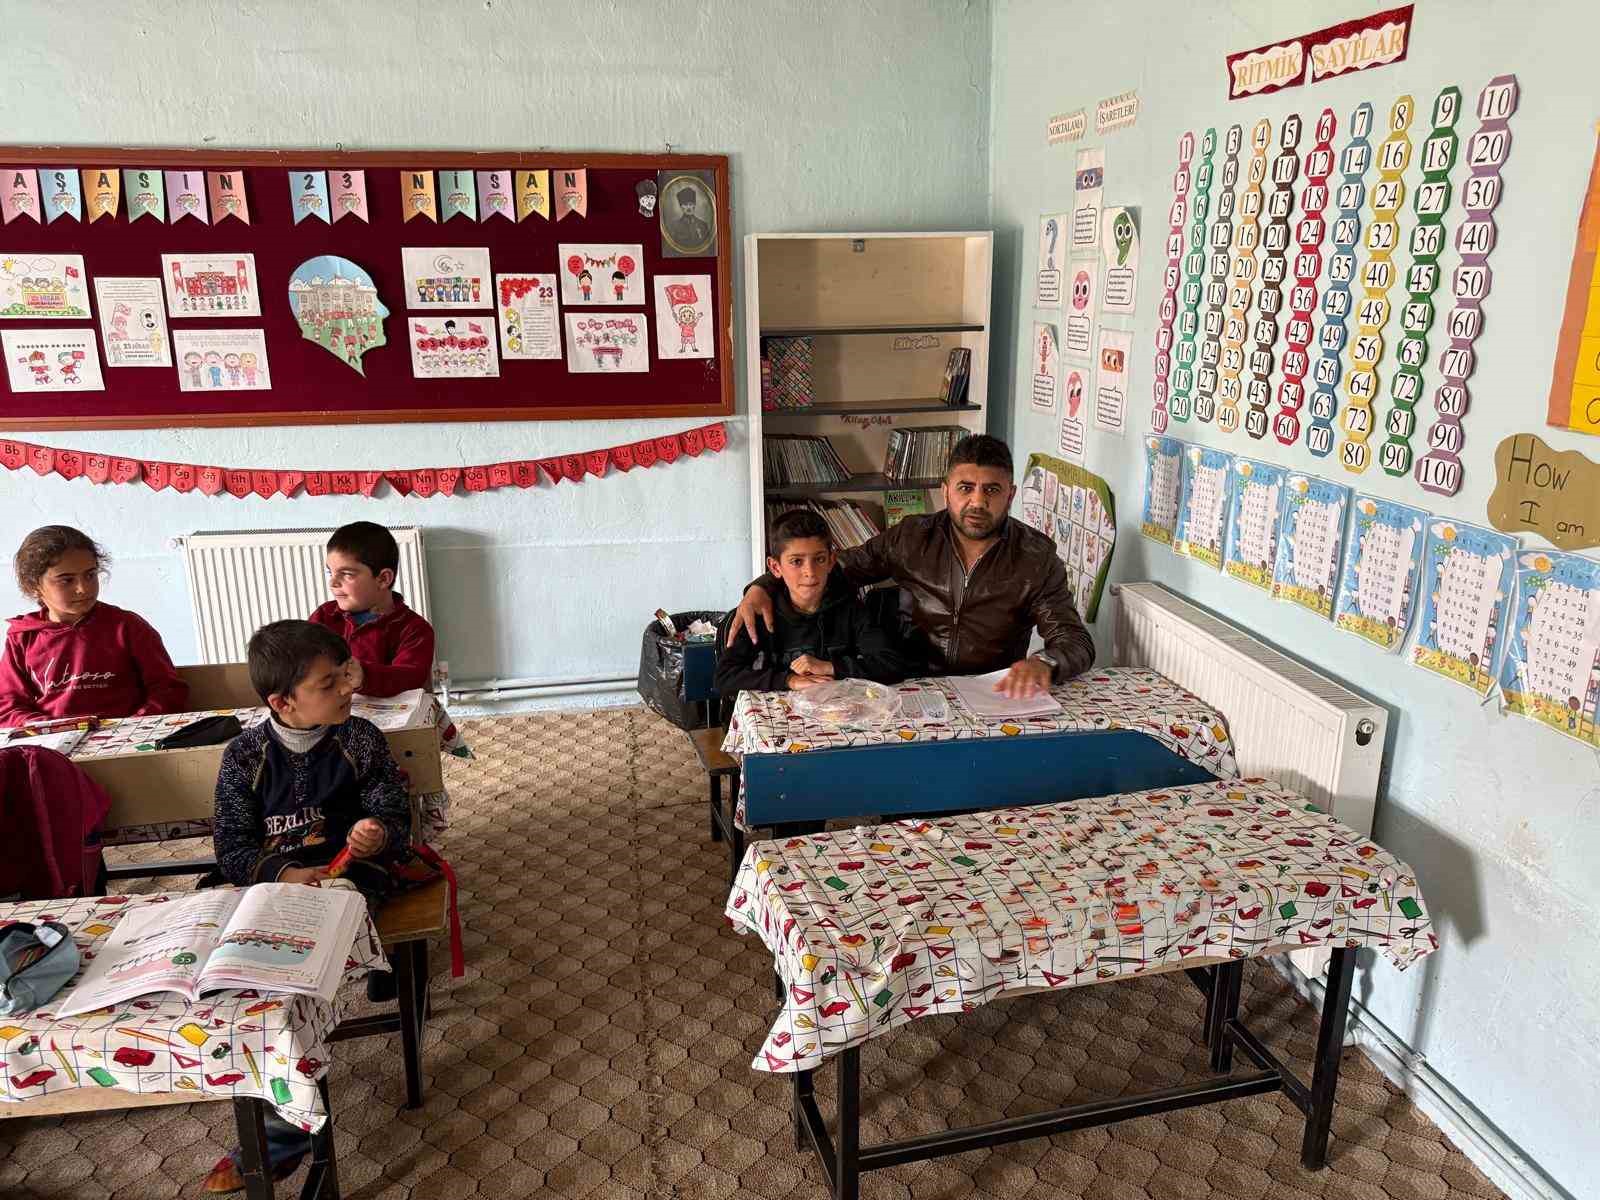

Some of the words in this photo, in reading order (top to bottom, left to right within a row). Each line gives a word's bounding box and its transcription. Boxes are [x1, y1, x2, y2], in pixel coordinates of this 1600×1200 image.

[1236, 51, 1299, 88] RİTMİK
[1439, 97, 1453, 122] 9
[1486, 88, 1510, 116] 10
[1049, 119, 1083, 135] NOKTALAMA
[1358, 112, 1366, 135] 7
[1396, 105, 1406, 129] 8
[1257, 126, 1265, 146] 4
[1287, 122, 1294, 145] 5
[1321, 118, 1329, 140] 6
[1185, 141, 1189, 159] 1
[1203, 137, 1210, 154] 2
[1230, 131, 1237, 151] 3
[1475, 136, 1503, 162] 20
[1312, 152, 1327, 175] 12
[1347, 151, 1364, 172] 14
[1383, 143, 1403, 168] 16
[1427, 141, 1449, 167] 18
[303, 174, 353, 190] 23
[412, 170, 576, 190] NİSAN
[1200, 170, 1208, 185] 4
[1226, 164, 1232, 181] 6
[1253, 160, 1261, 180] 8
[1278, 159, 1293, 180] 10
[1179, 174, 1185, 191] 2
[1245, 194, 1258, 214] 12
[1307, 188, 1323, 210] 18
[1341, 186, 1359, 208] 21
[1376, 184, 1397, 208] 24
[1421, 186, 1445, 210] 27
[1468, 180, 1495, 207] 30
[1175, 205, 1182, 222] 3
[1198, 199, 1204, 215] 6
[1223, 196, 1230, 215] 9
[1273, 195, 1288, 215] 15
[1195, 229, 1201, 244] 8
[1214, 226, 1228, 245] 12
[1241, 227, 1253, 245] 16
[1268, 227, 1284, 248] 20
[1302, 221, 1319, 242] 24
[1337, 221, 1353, 242] 28
[1370, 224, 1391, 248] 32
[1415, 228, 1439, 252] 36
[1463, 225, 1489, 250] 40
[1171, 238, 1178, 255] 4
[1189, 255, 1201, 271] 10
[1214, 256, 1226, 273] 15
[1236, 259, 1250, 279] 20
[1265, 261, 1281, 280] 25
[1298, 256, 1314, 277] 30
[1332, 257, 1352, 279] 35
[1169, 271, 1175, 286] 5
[1367, 264, 1389, 286] 40
[1411, 267, 1433, 291] 45
[1458, 271, 1483, 296] 50
[539, 287, 553, 298] 23
[1187, 285, 1197, 302] 12
[1210, 285, 1224, 302] 18
[1232, 289, 1247, 308] 24
[1262, 291, 1276, 310] 30
[1294, 288, 1312, 307] 36
[1327, 292, 1346, 314] 42
[1164, 301, 1171, 316] 6
[1361, 302, 1383, 325] 48
[1405, 307, 1427, 329] 54
[1184, 312, 1193, 332] 14
[1208, 313, 1219, 332] 21
[1229, 321, 1242, 339] 28
[1257, 323, 1272, 342] 35
[1290, 321, 1307, 343] 42
[1453, 312, 1476, 336] 60
[1162, 331, 1168, 345] 7
[1323, 326, 1340, 347] 49
[1180, 342, 1192, 361] 16
[1204, 343, 1216, 360] 24
[1355, 338, 1376, 360] 56
[1401, 342, 1423, 364] 63
[1159, 358, 1165, 373] 8
[1224, 350, 1238, 370] 32
[1254, 353, 1268, 372] 40
[1287, 351, 1303, 374] 48
[1449, 351, 1468, 376] 70
[1177, 371, 1188, 389] 18
[1200, 370, 1214, 388] 27
[1319, 361, 1335, 382] 56
[1157, 385, 1163, 402] 9
[1222, 379, 1236, 399] 36
[1251, 382, 1266, 404] 45
[1351, 373, 1371, 396] 64
[1398, 376, 1417, 399] 72
[1174, 398, 1186, 416] 20
[1282, 385, 1298, 408] 54
[1314, 395, 1331, 416] 63
[1439, 387, 1461, 413] 80
[1154, 410, 1163, 425] 10
[1197, 398, 1210, 417] 30
[1220, 408, 1234, 426] 40
[1249, 411, 1263, 432] 50
[1278, 417, 1294, 438] 60
[1349, 409, 1366, 431] 72
[1390, 411, 1409, 434] 81
[1312, 429, 1328, 450] 70
[1434, 425, 1456, 450] 90
[1344, 443, 1364, 466] 80
[1386, 445, 1405, 470] 90
[1508, 435, 1570, 491] How
[5, 445, 19, 455] Bb
[90, 458, 105, 467] Dd
[117, 462, 132, 471] Ee
[337, 476, 351, 486] Kk
[416, 474, 431, 483] Nn
[1423, 460, 1456, 487] 100
[1519, 501, 1540, 526] I
[1557, 521, 1585, 537] am
[1578, 603, 1587, 612] 21
[1541, 620, 1545, 628] 7
[1572, 631, 1583, 640] 35
[1576, 617, 1585, 626] 28
